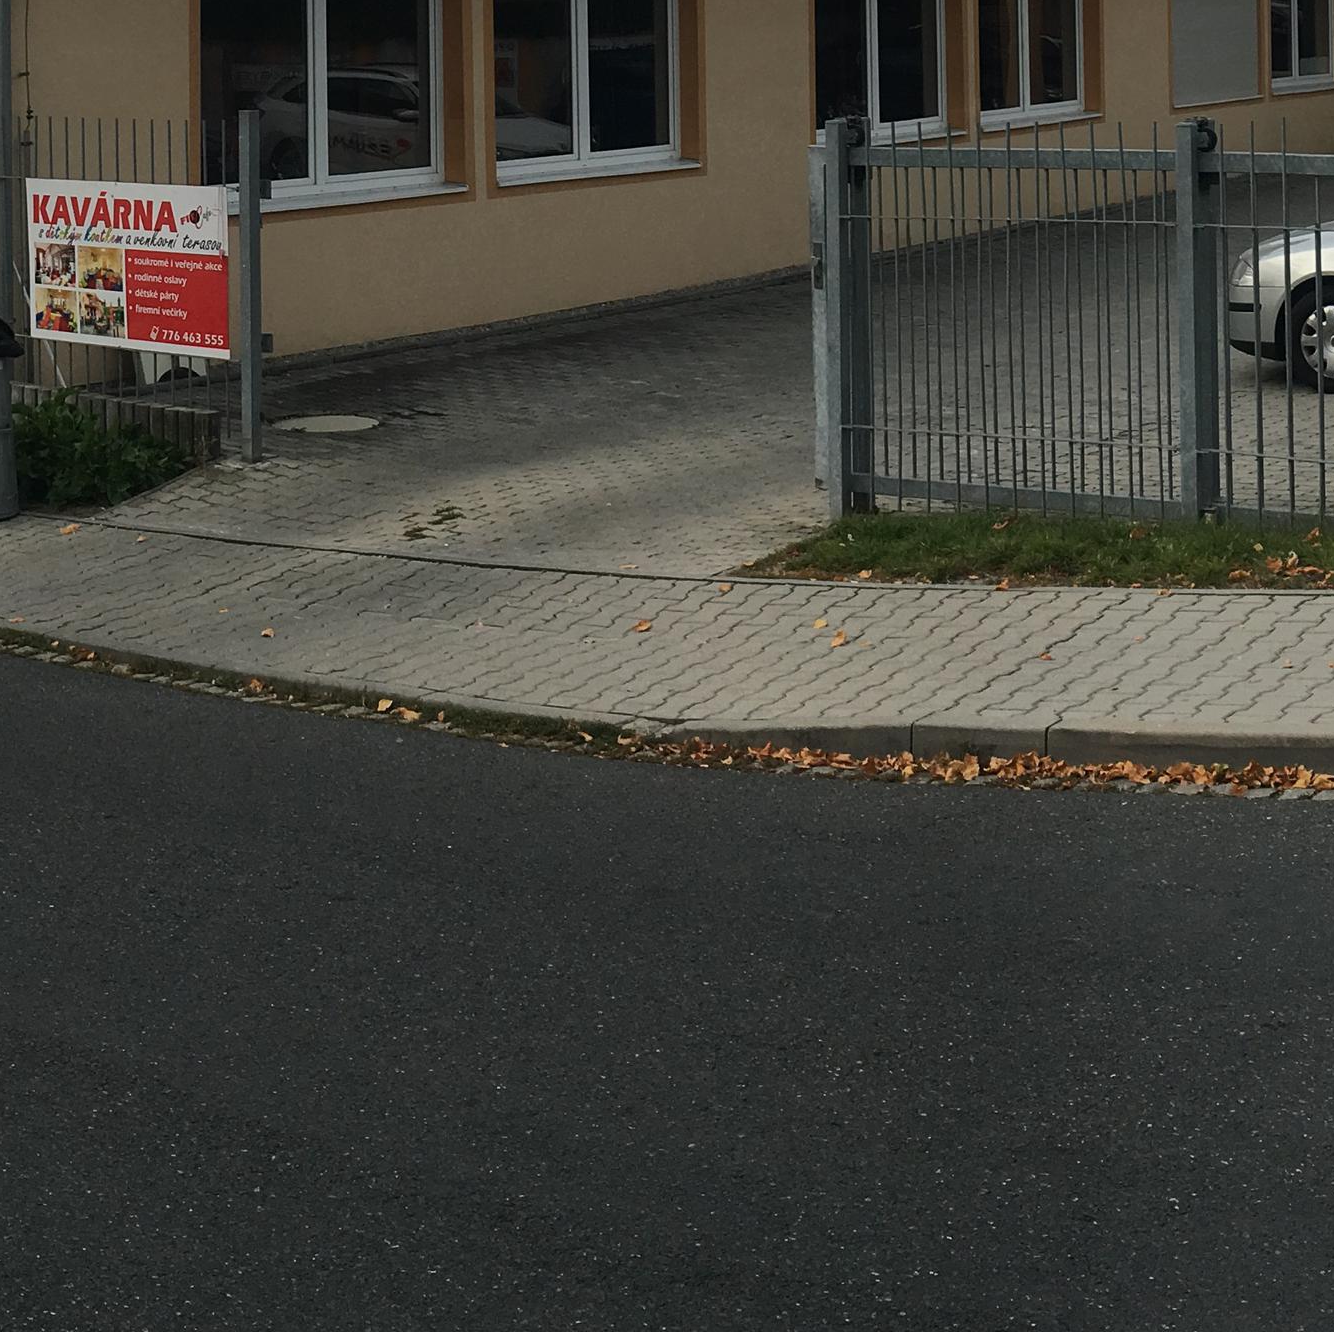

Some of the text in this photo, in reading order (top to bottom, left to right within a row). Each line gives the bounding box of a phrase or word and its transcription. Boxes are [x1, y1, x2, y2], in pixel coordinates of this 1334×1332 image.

[32, 191, 178, 233] KAVÁRNA
[125, 234, 132, 246] a
[182, 234, 222, 251] terasou
[134, 257, 169, 268] soukromé
[204, 262, 223, 272] akce
[134, 273, 187, 287] rodinné oslavy
[159, 292, 180, 303] párty
[161, 307, 188, 320] večírky
[162, 329, 224, 346] 776 463 555
